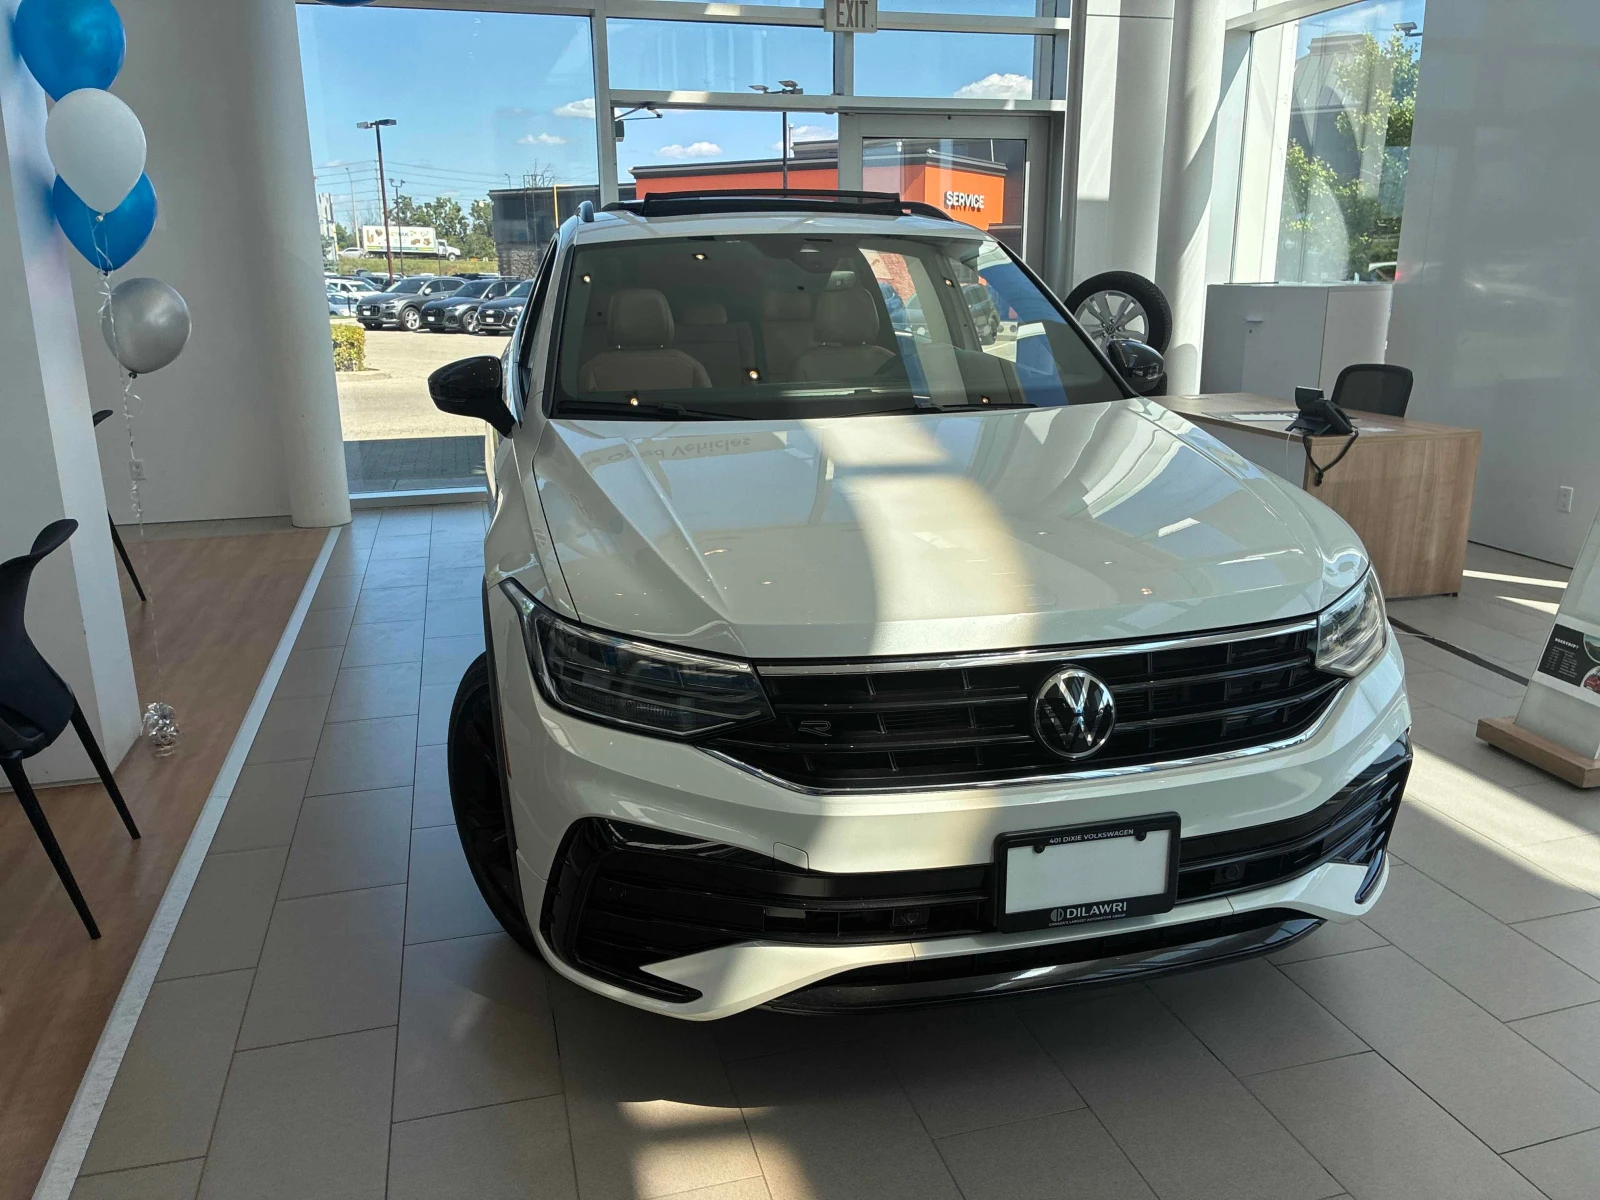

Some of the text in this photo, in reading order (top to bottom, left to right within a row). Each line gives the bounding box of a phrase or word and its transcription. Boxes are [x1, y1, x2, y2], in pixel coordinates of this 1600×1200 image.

[836, 0, 868, 28] EXIT
[946, 191, 985, 209] SERVICE
[1049, 828, 1134, 845] 401 DIXIE VOLKSWAGEN
[1066, 901, 1127, 919] DILAWRI
